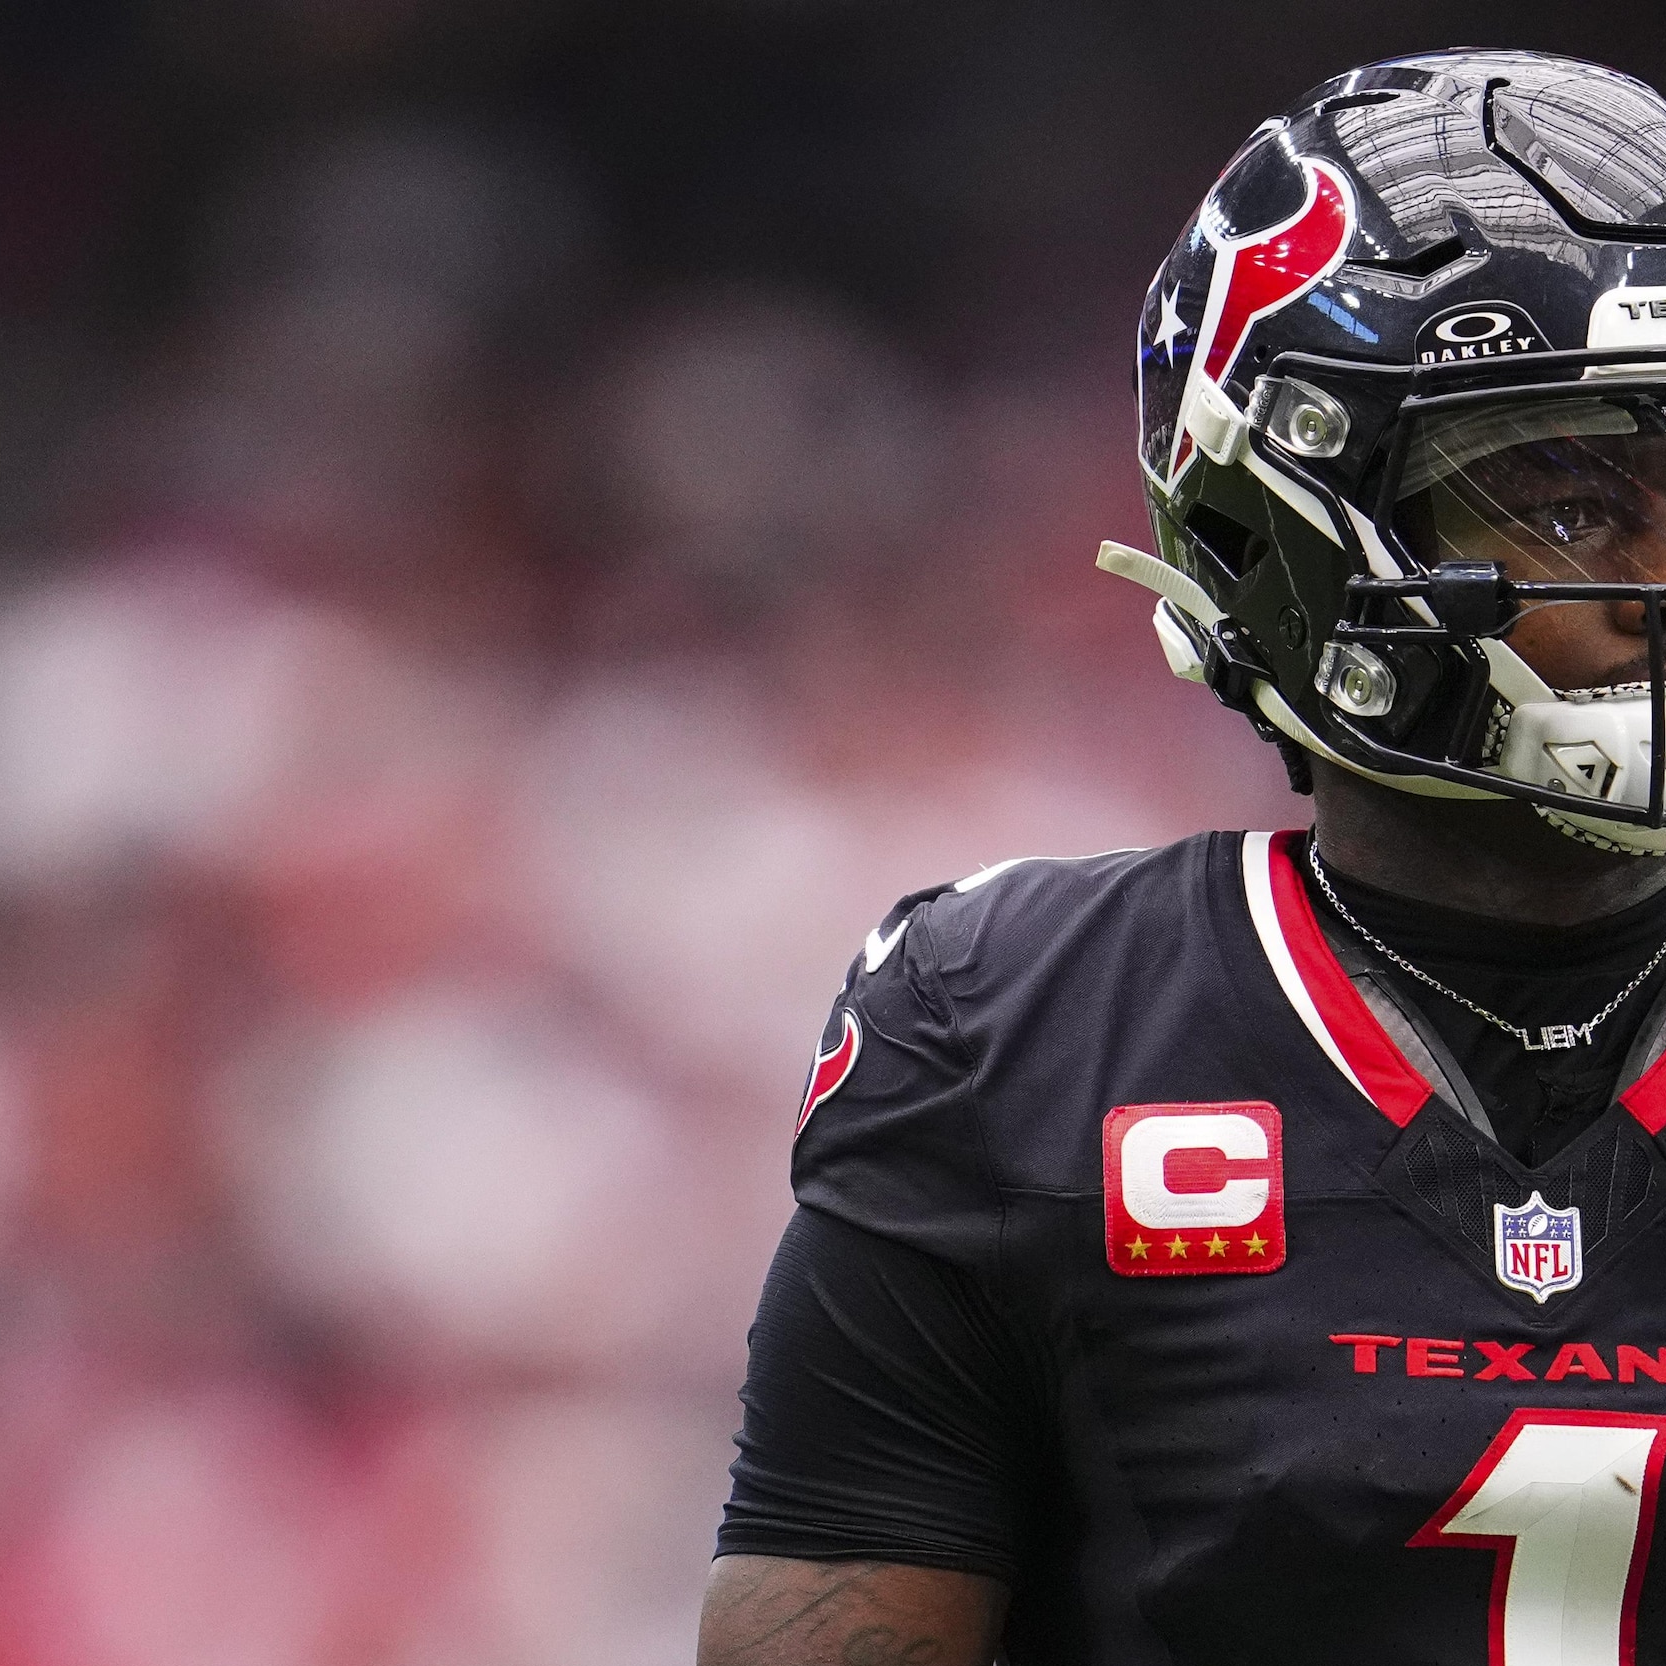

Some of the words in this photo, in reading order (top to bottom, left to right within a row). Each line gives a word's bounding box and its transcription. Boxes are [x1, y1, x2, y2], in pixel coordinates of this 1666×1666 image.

[1420, 336, 1533, 365] OAKLEY
[1120, 1113, 1270, 1230] C
[1509, 1242, 1569, 1283] NFL
